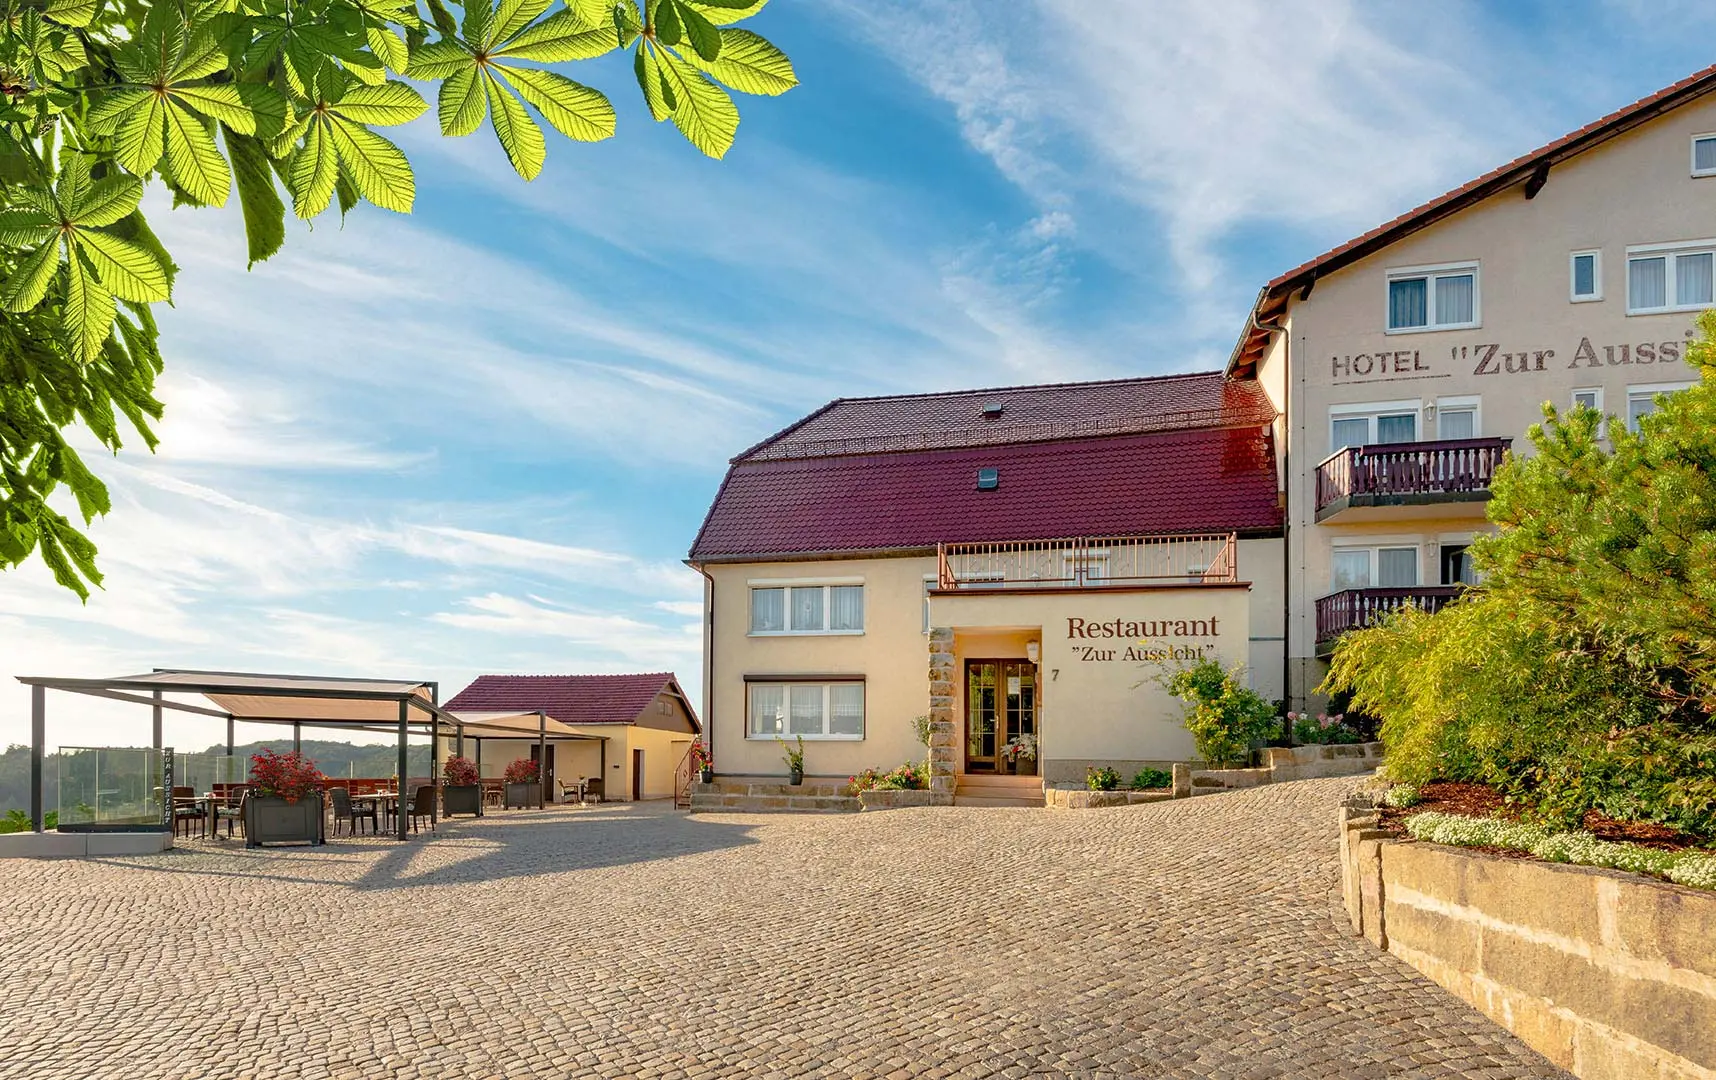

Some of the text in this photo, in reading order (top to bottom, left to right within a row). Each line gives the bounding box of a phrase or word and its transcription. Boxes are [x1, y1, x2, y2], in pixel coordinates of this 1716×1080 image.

[1332, 350, 1430, 377] HOTEL
[1567, 329, 1694, 369] Auss
[1067, 616, 1220, 639] Restaurant
[1052, 669, 1060, 681] 7
